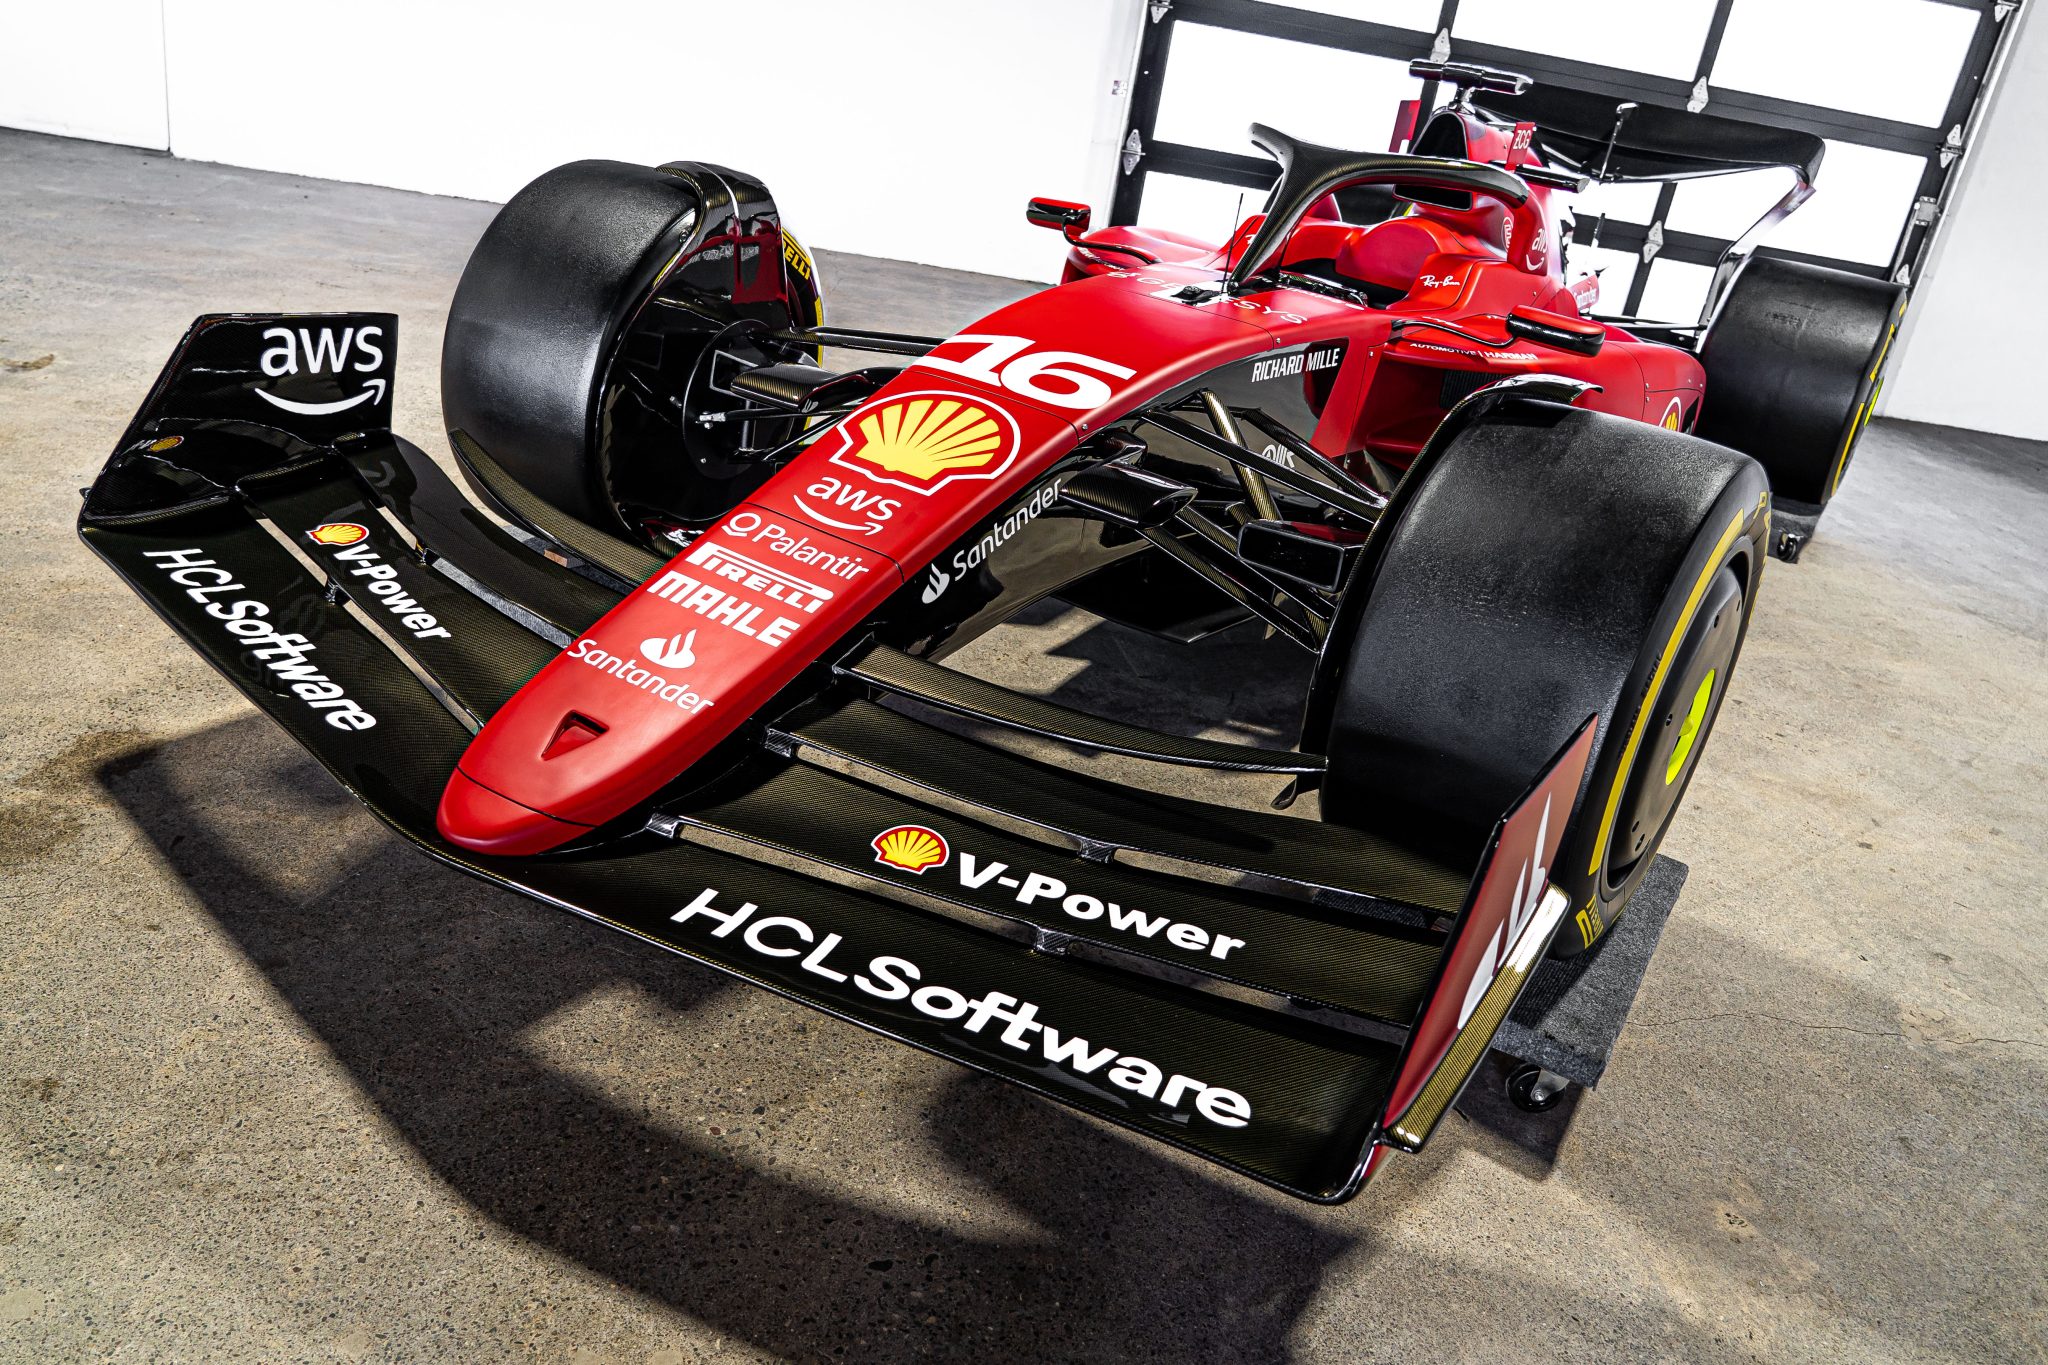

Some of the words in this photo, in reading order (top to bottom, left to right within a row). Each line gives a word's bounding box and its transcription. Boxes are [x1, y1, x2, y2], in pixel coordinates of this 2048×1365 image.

[1513, 130, 1531, 149] ZCG
[261, 326, 385, 378] aws
[913, 333, 1138, 411] 16
[1252, 355, 1304, 383] RICHARD
[1305, 347, 1341, 371] MILLE
[1409, 342, 1477, 356] AUTOMOTIVE
[1484, 351, 1539, 361] HARMAN
[806, 476, 902, 522] aws
[953, 478, 1062, 582] Santander
[331, 540, 452, 640] V-Power
[685, 541, 835, 615] PIRELLI
[753, 521, 869, 581] Palantir
[142, 547, 377, 732] HCLSoftware
[646, 570, 801, 648] MAHLE
[566, 638, 714, 716] Santander
[959, 851, 1246, 960] V-Power
[670, 887, 1251, 1128] HCLSoftware
